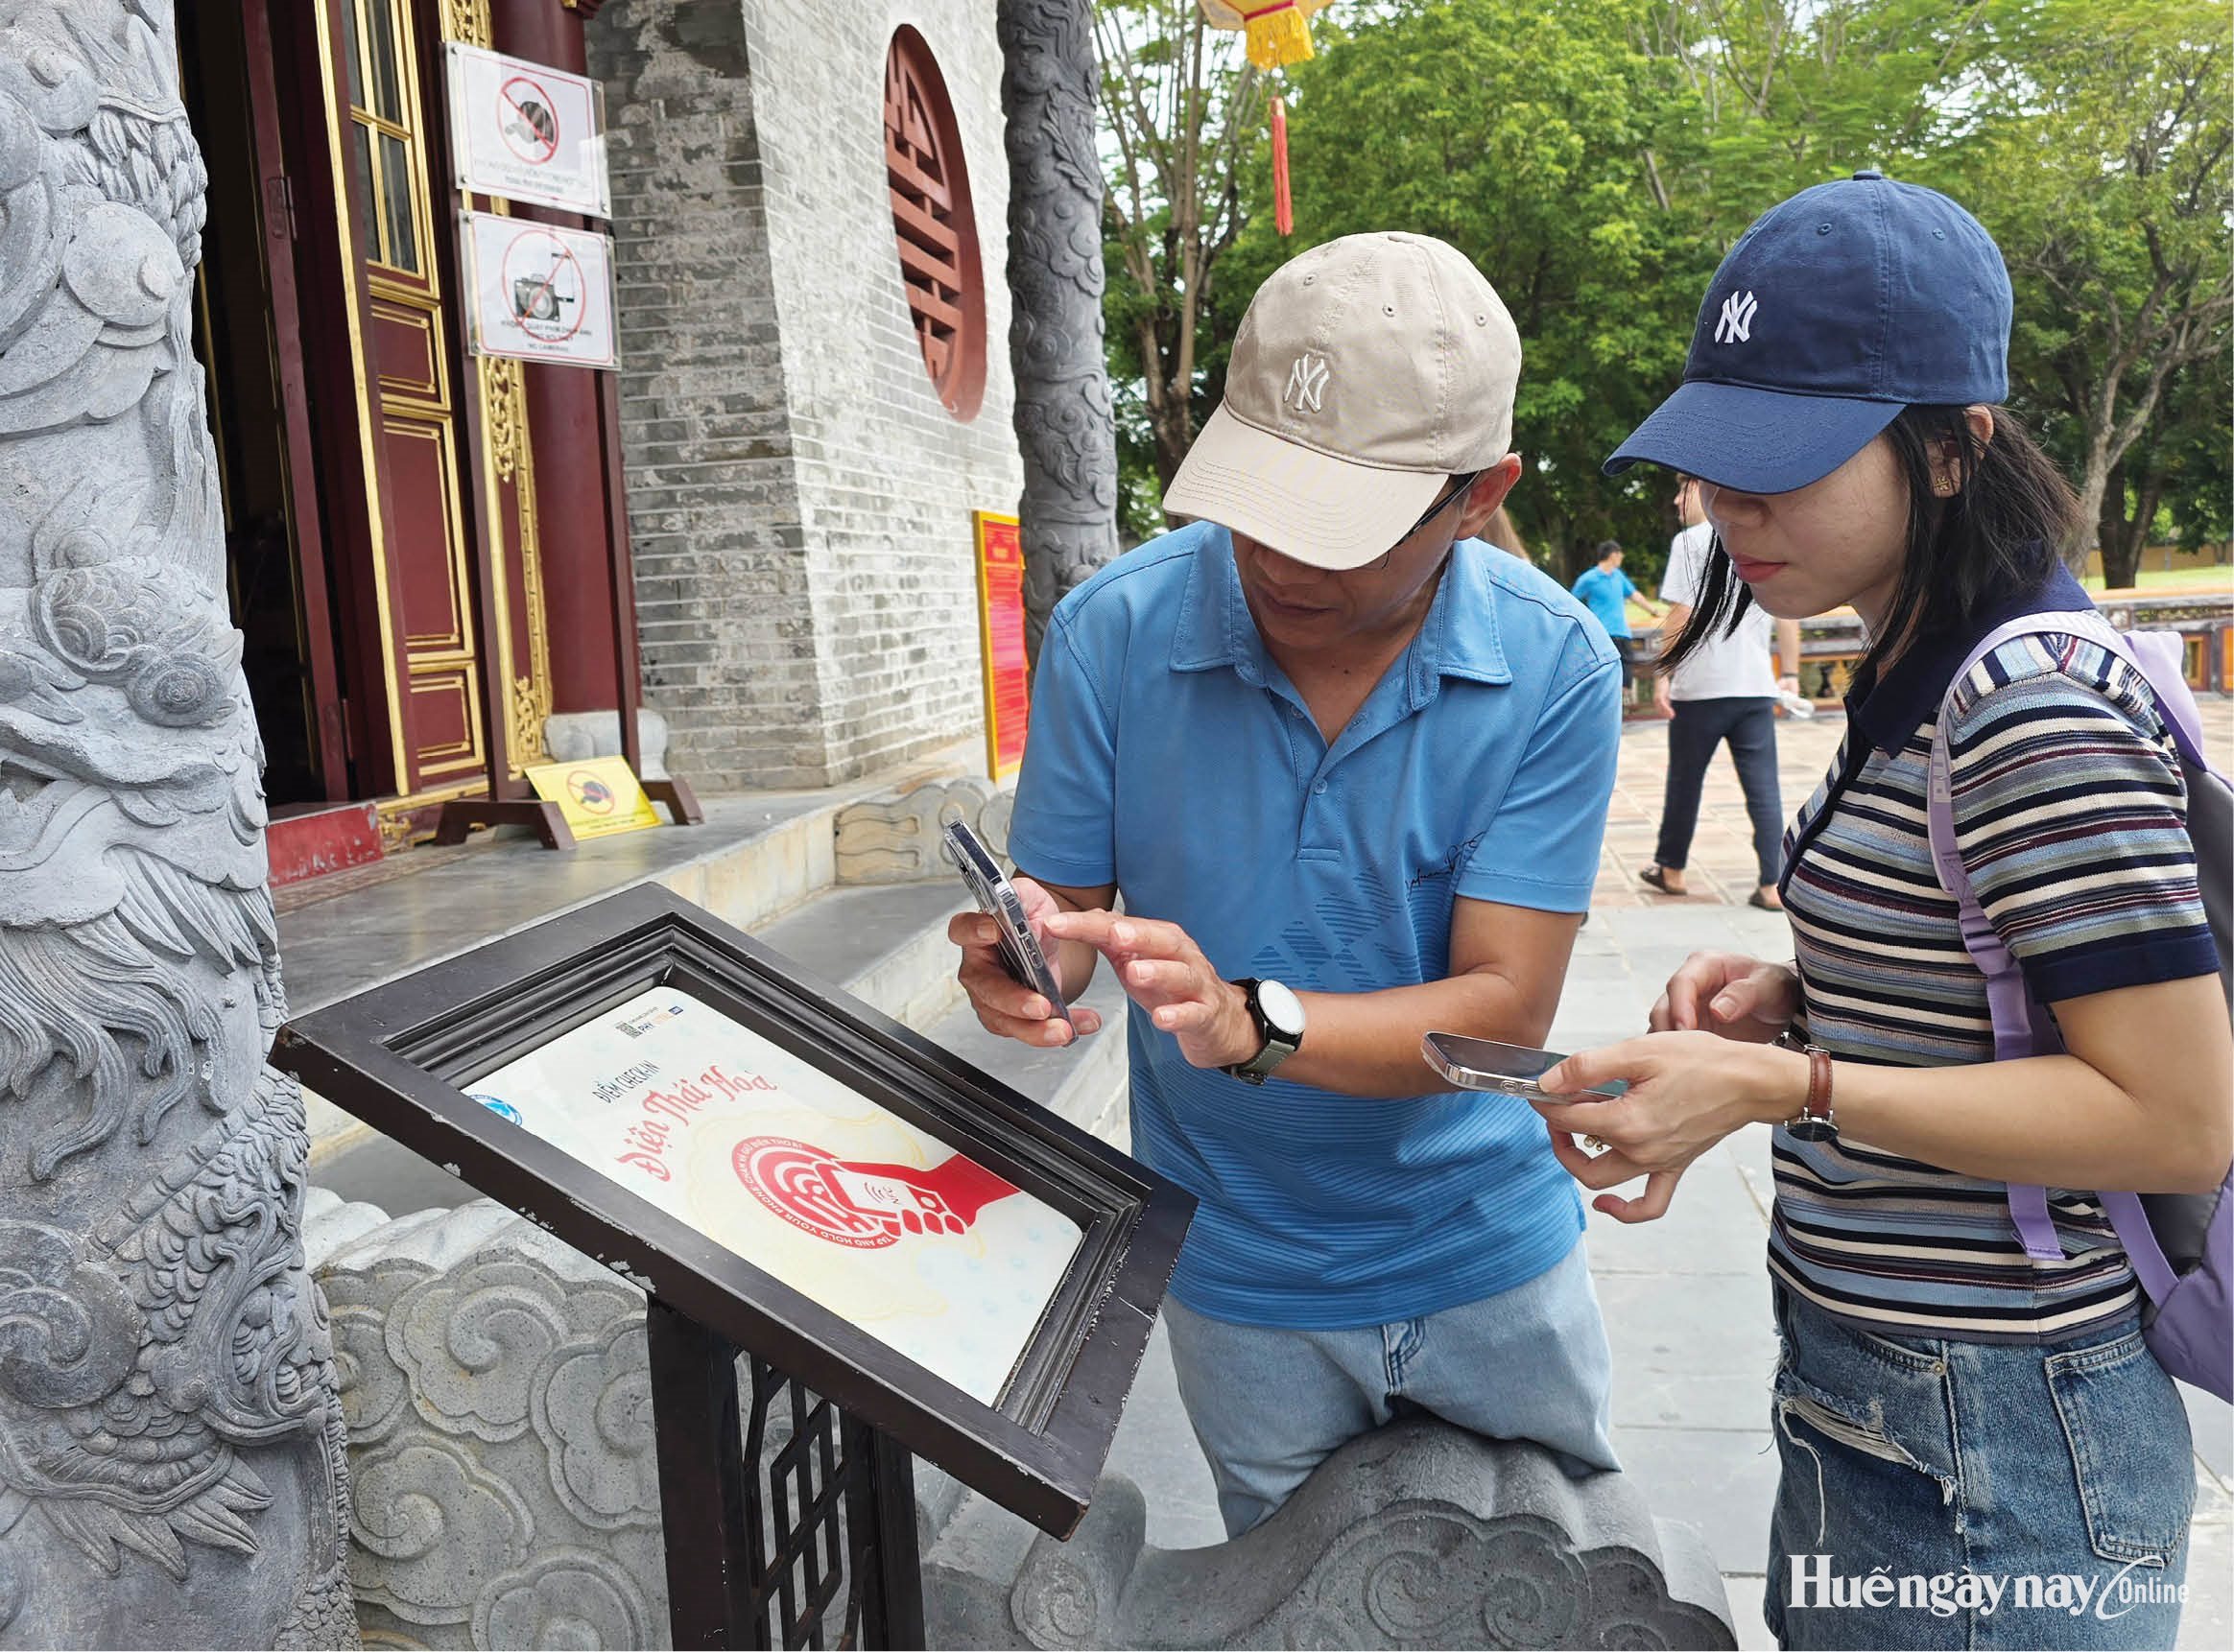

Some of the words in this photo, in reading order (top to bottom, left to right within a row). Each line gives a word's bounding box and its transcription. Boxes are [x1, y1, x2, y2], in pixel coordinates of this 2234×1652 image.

[1714, 291, 1757, 343] NY
[1283, 353, 1330, 413] NY
[614, 1059, 660, 1090] CHECK-IN
[700, 1065, 777, 1102] Hoà
[643, 1078, 713, 1126] Thái
[614, 1121, 674, 1182] Điện
[751, 1185, 784, 1214] PHONE
[784, 1214, 818, 1234] YOUR
[820, 1231, 853, 1244] HOLD
[854, 1238, 875, 1247] AND
